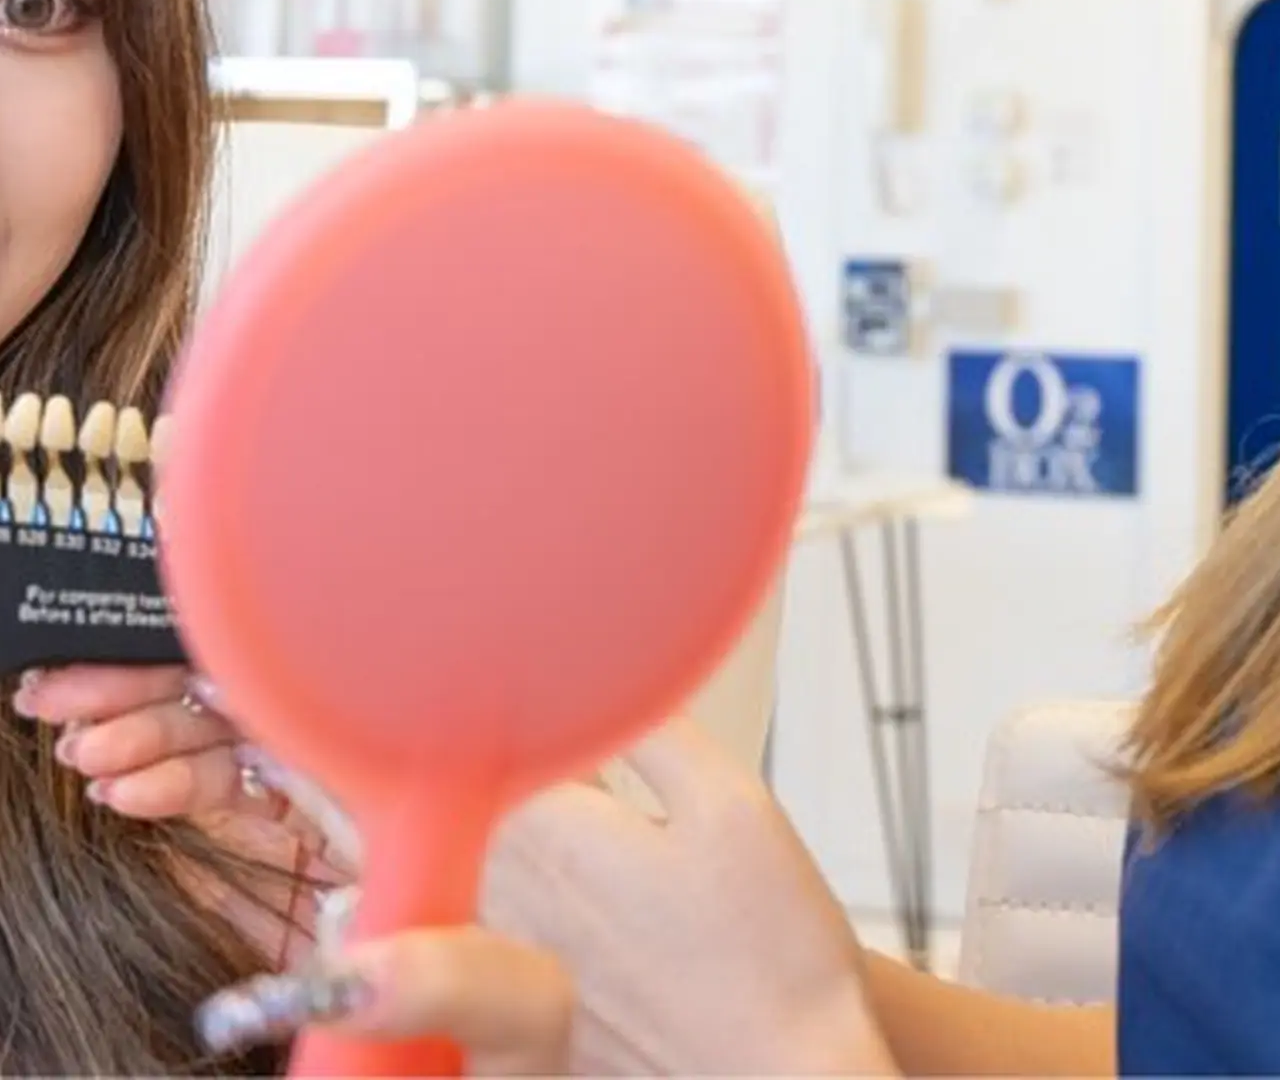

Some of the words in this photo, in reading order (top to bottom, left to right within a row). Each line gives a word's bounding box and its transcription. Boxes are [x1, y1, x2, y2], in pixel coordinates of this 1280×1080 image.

[986, 439, 1100, 494] BOX
[91, 536, 122, 556] S32
[18, 602, 71, 624] Before
